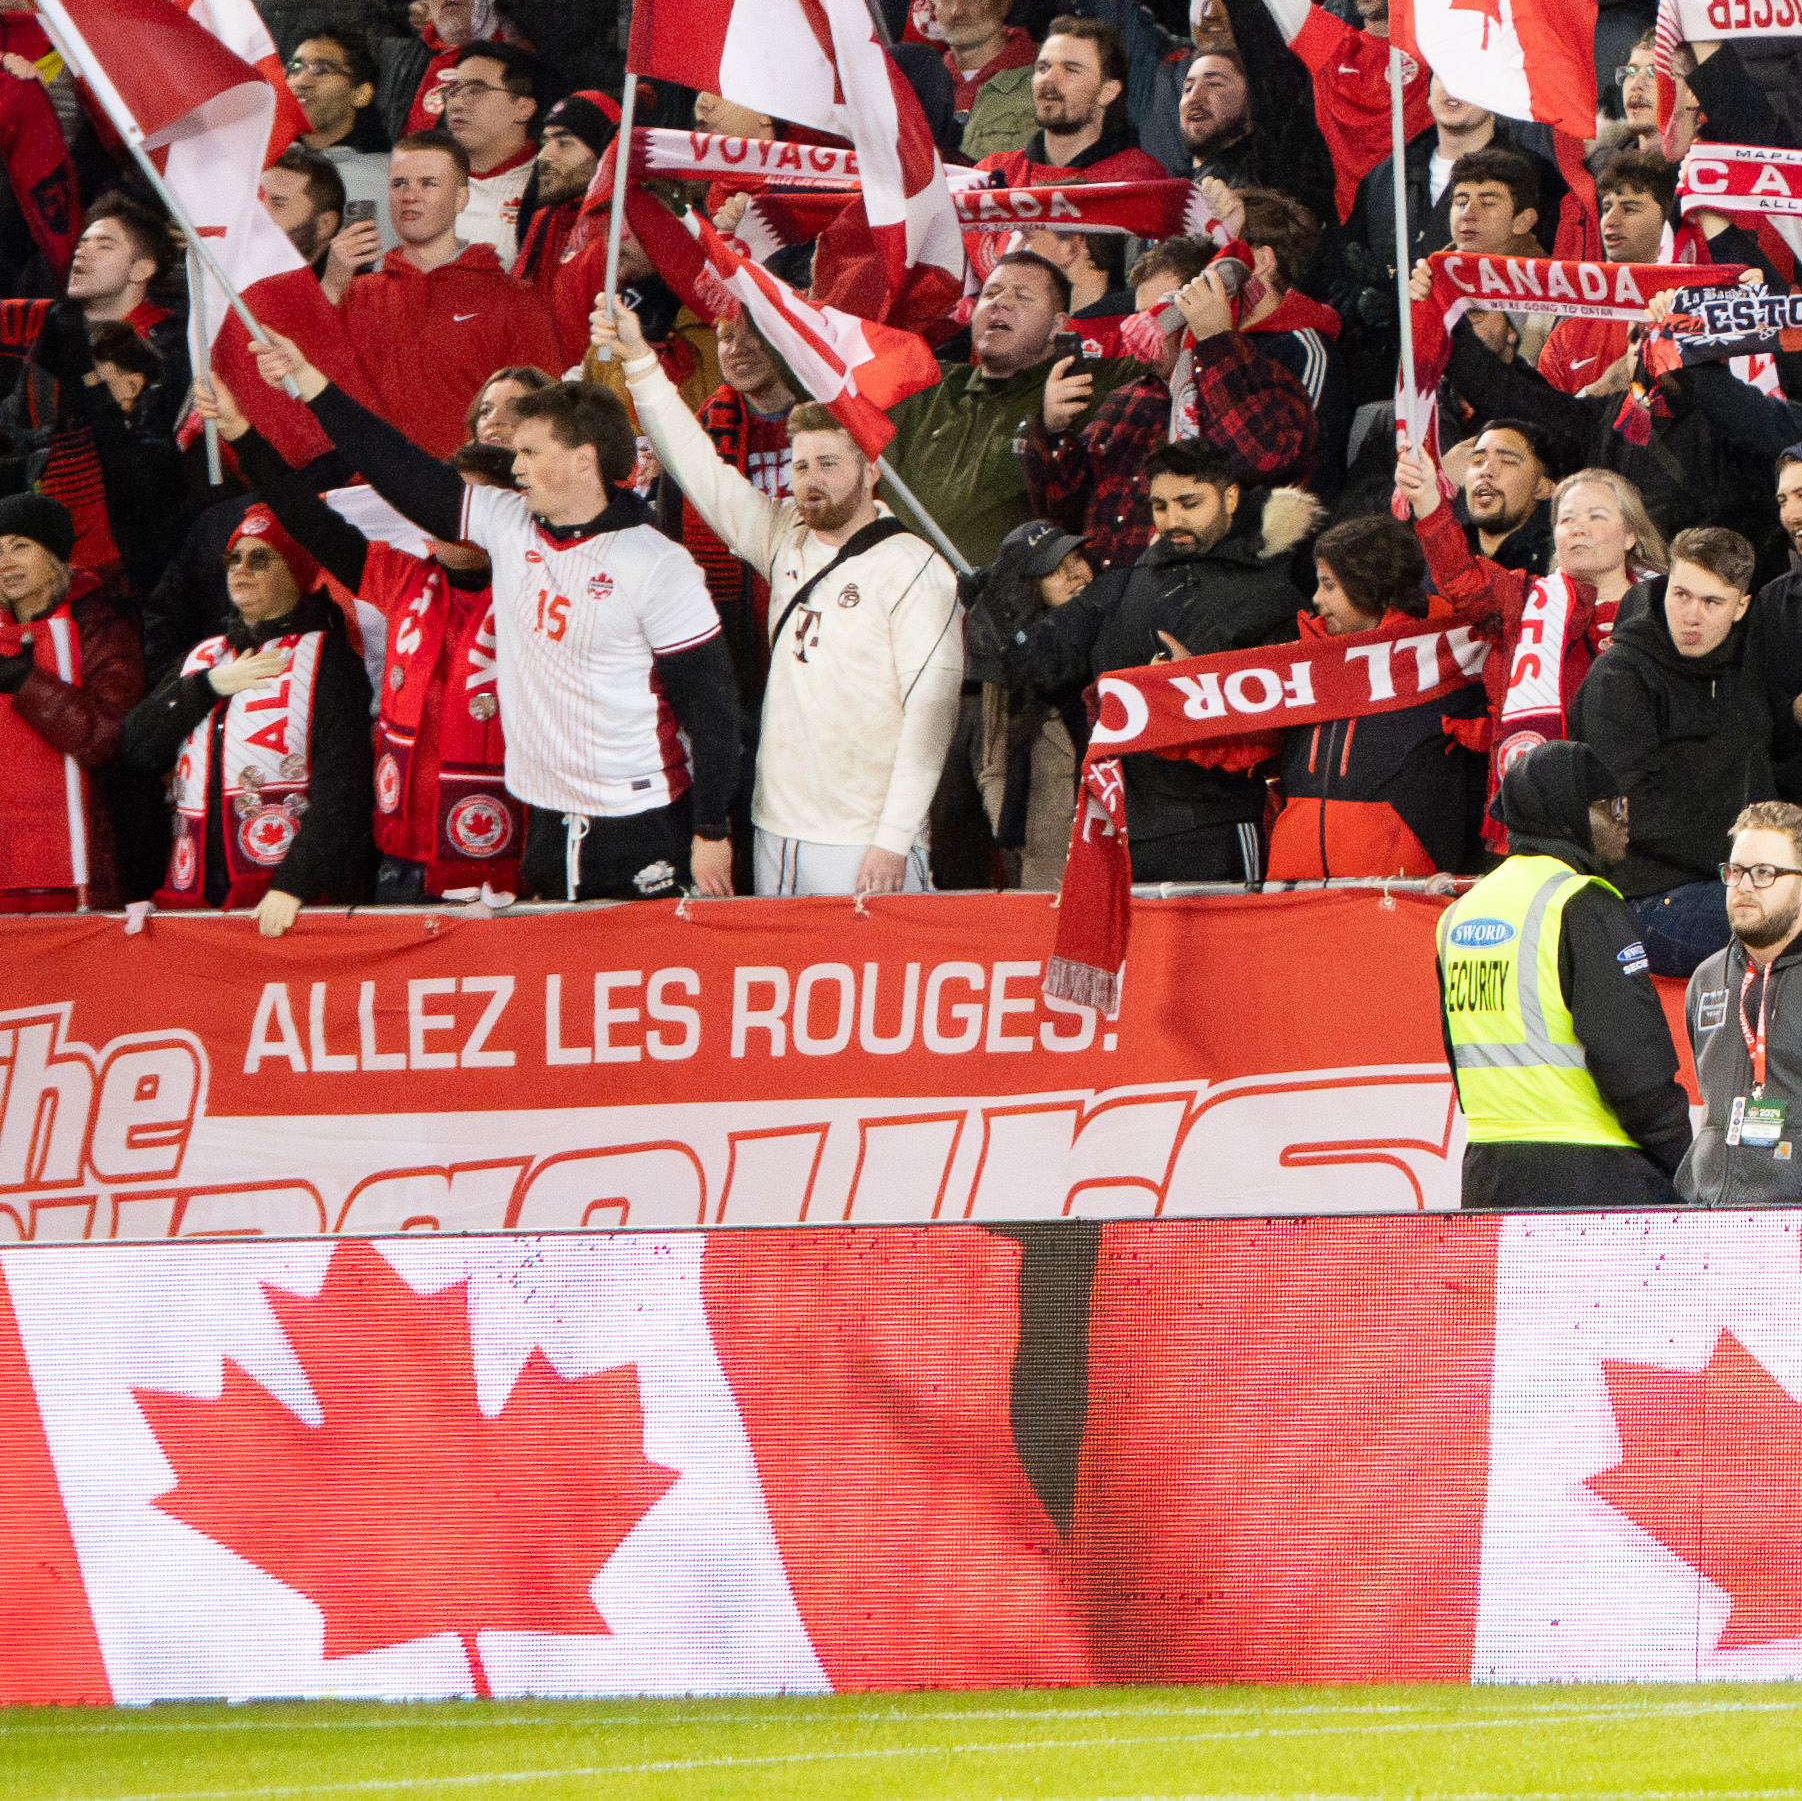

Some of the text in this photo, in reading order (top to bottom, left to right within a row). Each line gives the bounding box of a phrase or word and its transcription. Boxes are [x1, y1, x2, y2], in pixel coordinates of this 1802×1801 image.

[689, 131, 862, 177] VOYAGE
[957, 190, 1077, 220] NADA
[1442, 255, 1641, 306] CANADA
[1525, 302, 1557, 314] GOING
[1562, 304, 1577, 315] TO
[537, 588, 569, 641] 15
[1170, 663, 1318, 720] FOR
[1454, 923, 1508, 941] SWORD
[244, 959, 1121, 1073] ALLEZ LES ROUGES!
[0, 1003, 207, 1185] he
